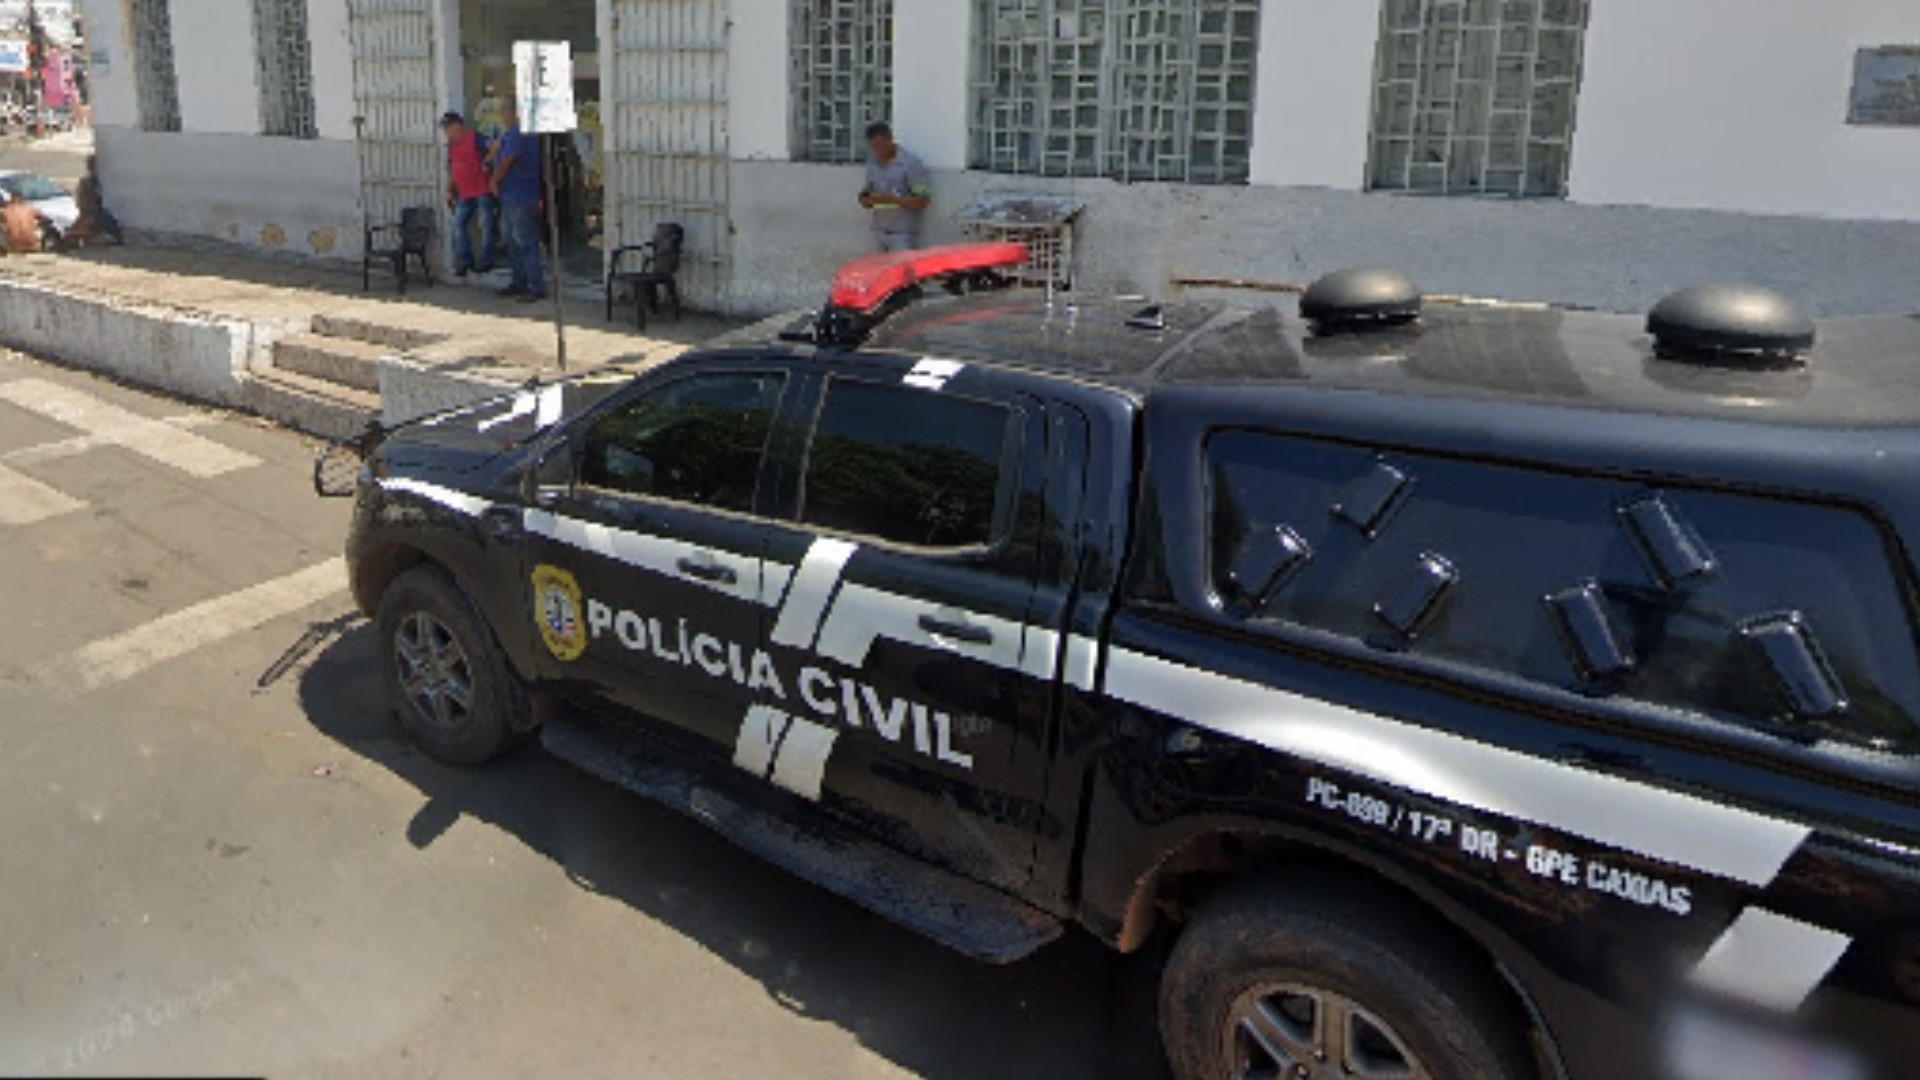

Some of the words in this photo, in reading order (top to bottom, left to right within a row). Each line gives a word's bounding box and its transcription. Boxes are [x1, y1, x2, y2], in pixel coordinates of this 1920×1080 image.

[586, 597, 788, 699] POLÍCIA
[797, 665, 974, 769] CIVIL
[1460, 823, 1499, 864] DR
[1525, 844, 1579, 886] GPE
[1585, 860, 1692, 917] CAXIAS
